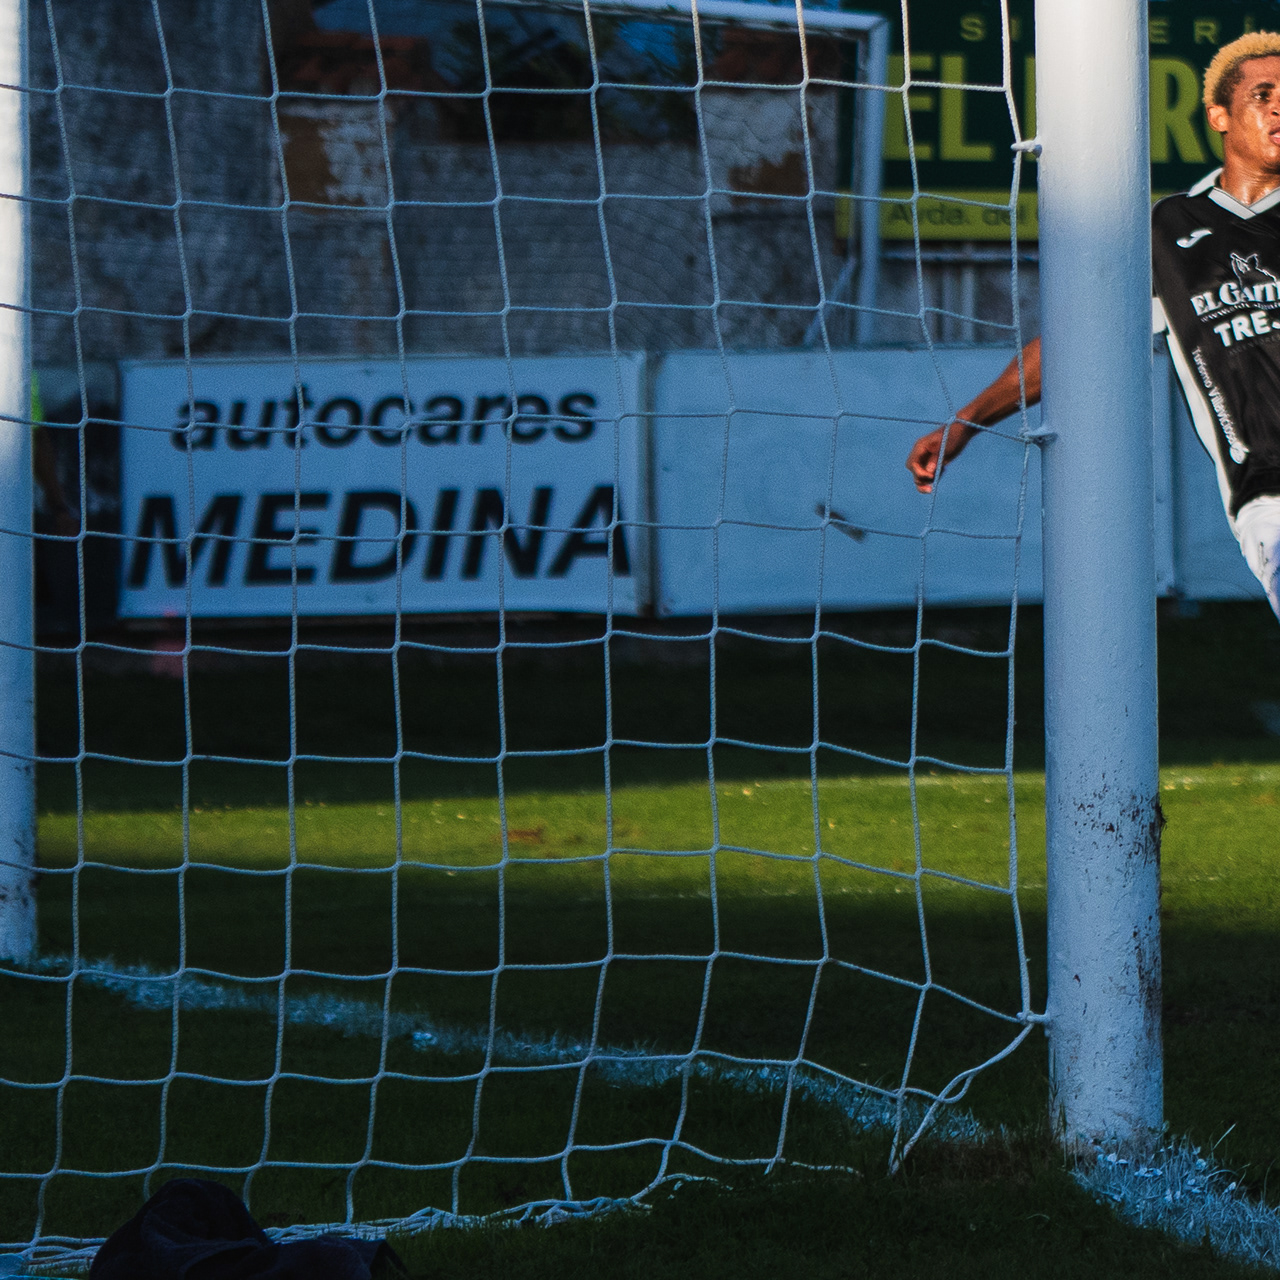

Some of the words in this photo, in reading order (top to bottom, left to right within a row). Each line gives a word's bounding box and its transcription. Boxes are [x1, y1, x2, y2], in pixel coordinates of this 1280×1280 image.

[885, 54, 993, 162] EL
[1190, 291, 1222, 317] EL
[170, 385, 598, 451] autocares
[127, 483, 632, 590] MEDINA
